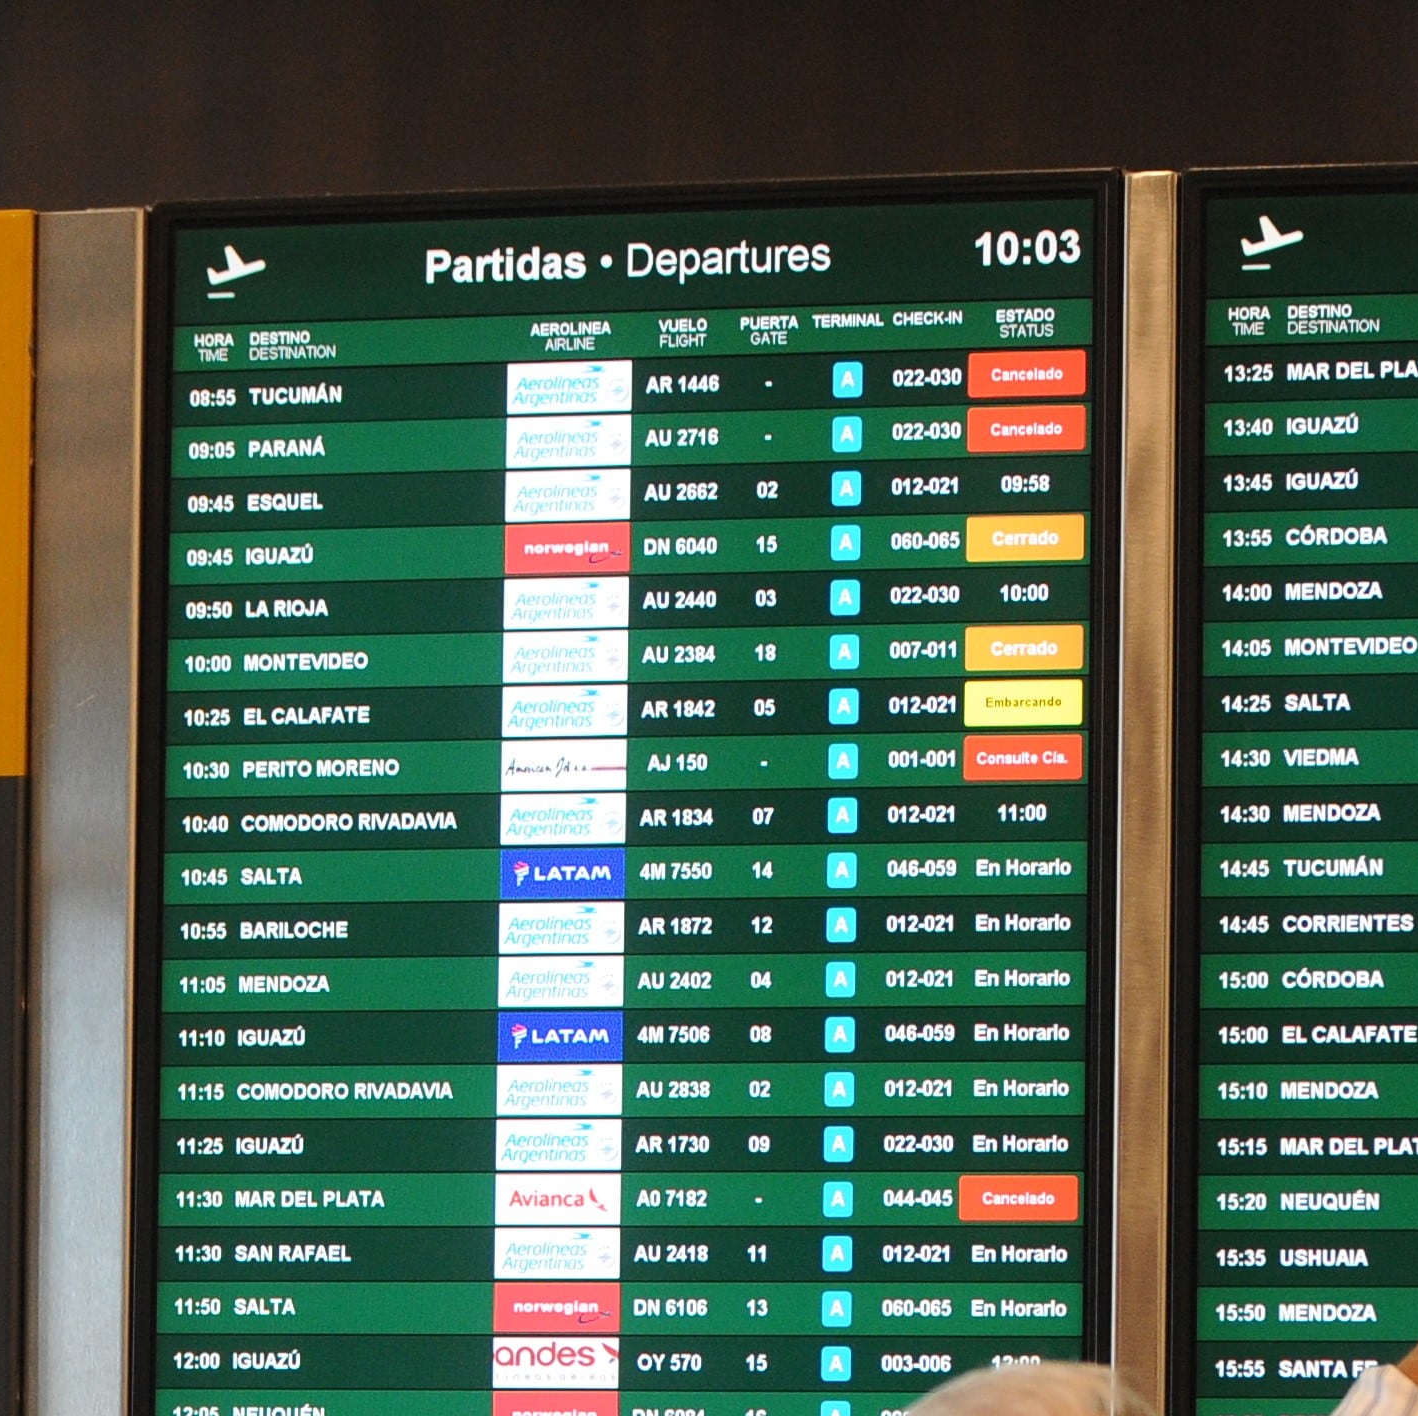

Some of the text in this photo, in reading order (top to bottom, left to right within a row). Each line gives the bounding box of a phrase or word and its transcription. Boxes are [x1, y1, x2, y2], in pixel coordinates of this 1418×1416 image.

[426, 230, 1080, 284] Partidas Departures 10:03
[1229, 306, 1270, 320] HORA
[1288, 304, 1352, 319] DESTINO
[195, 308, 1055, 347] HORA DESTINO AEROLINEA VUELO PUERTA TERMINAL CHECK-IN ESTADO
[1233, 322, 1264, 335] TIME
[1288, 318, 1379, 334] DESTINATION
[198, 324, 1053, 361] TIME DESTINATION AIRLINE FLIGHT GATE STATUS
[190, 367, 1063, 406] 08:55 TUCUMÁN AR 1446 A 022-030 Cancelado
[1224, 418, 1273, 436] 13:40
[1287, 413, 1358, 434] IGUAZÚ
[185, 696, 1062, 726] 10:25 EL CALAFATE AR 1842 05 A 012-021 Embarcando
[1221, 805, 1270, 822] 14:30
[1284, 804, 1381, 822] MENDOZA
[182, 858, 1071, 885] 10:45 SALTA LATAM 4M 7550 14 A 046-059 En Horario
[1217, 1249, 1266, 1266] 15:35
[1280, 1249, 1368, 1266] USHUAIA
[175, 1298, 221, 1314] 11:50
[234, 1298, 295, 1314] SALTA
[634, 1299, 660, 1315] DN
[666, 1299, 707, 1316] 6106
[747, 1299, 768, 1316] 13
[829, 1299, 844, 1316] A
[882, 1299, 952, 1316] 060-065
[972, 1299, 996, 1316] En
[1001, 1300, 1067, 1316] Horario
